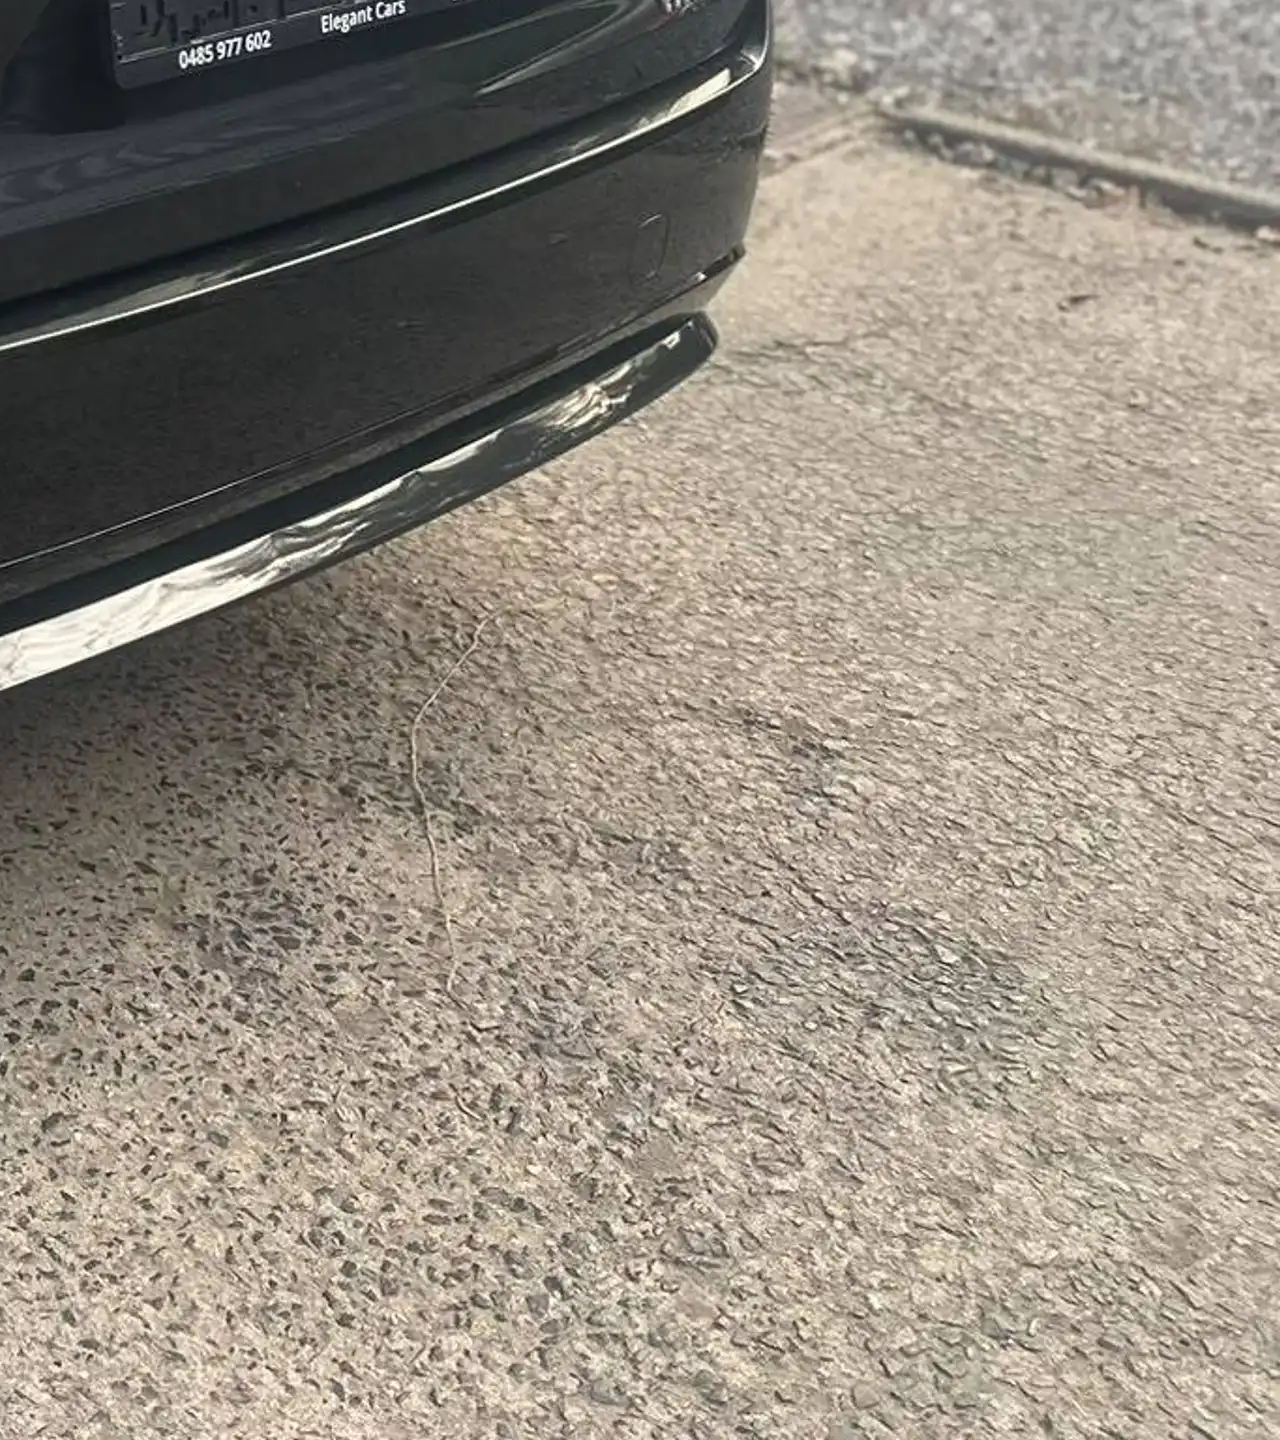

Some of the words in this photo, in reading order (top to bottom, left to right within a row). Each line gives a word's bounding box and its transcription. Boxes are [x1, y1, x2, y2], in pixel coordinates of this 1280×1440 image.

[321, 5, 373, 33] Elegant
[375, 0, 406, 19] Cars
[179, 43, 214, 69] 0485
[216, 36, 242, 60] 977
[245, 29, 272, 52] 602
